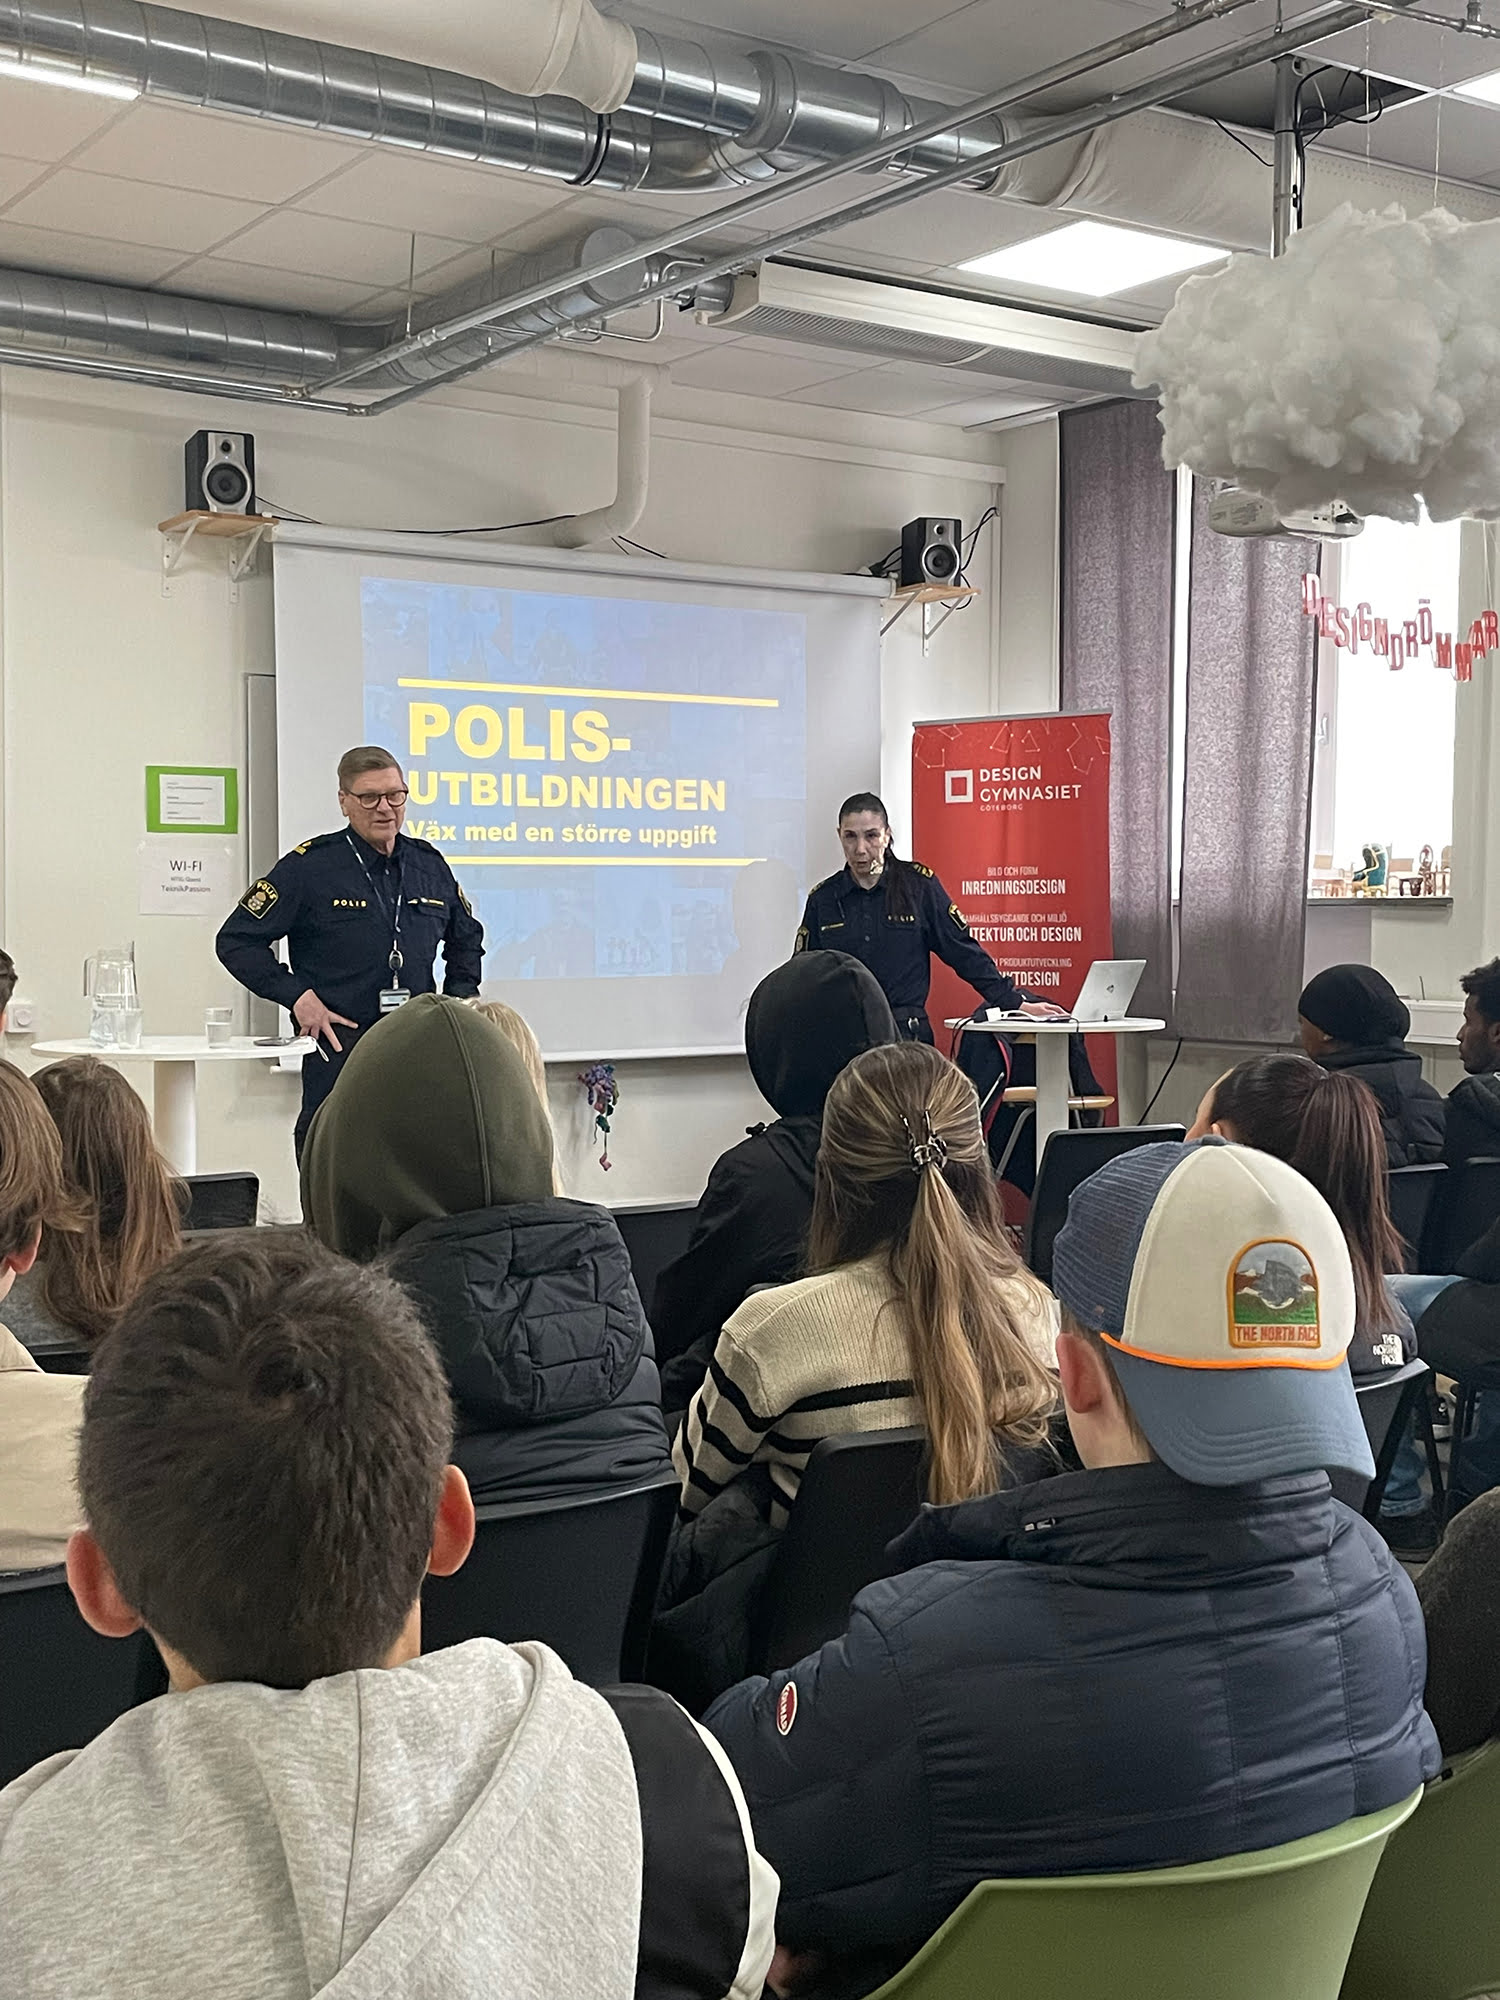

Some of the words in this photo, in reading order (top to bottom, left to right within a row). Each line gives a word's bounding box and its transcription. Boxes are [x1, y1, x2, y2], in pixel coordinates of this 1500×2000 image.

[409, 702, 631, 763] POLIS-
[980, 765, 1041, 782] DESIGN
[408, 771, 726, 811] UTBILDNINGEN
[980, 785, 1081, 802] GYMNASIET
[980, 803, 1023, 812] GÖTEBORG
[406, 820, 456, 841] Väx
[465, 822, 517, 841] med
[525, 825, 554, 842] en
[562, 823, 631, 843] större
[638, 825, 717, 848] uppgift
[170, 860, 201, 871] WI-FI
[987, 866, 1002, 876] BILD
[1003, 866, 1018, 876] OCH
[1019, 866, 1038, 876] FORM
[257, 882, 277, 899] POLIS
[962, 880, 1065, 895] INREDNINGSDESIGN
[333, 899, 367, 907] POLIS
[1031, 913, 1046, 923] OCH
[1047, 911, 1067, 923] MILJÖ
[969, 926, 1014, 942] ITEKTUR
[1017, 927, 1038, 941] OCH
[1041, 926, 1082, 942] DESIGN
[1000, 957, 1072, 967] PRODUKTUTVECKLING
[1235, 1326, 1257, 1341] THE
[1261, 1326, 1295, 1341] NORTH
